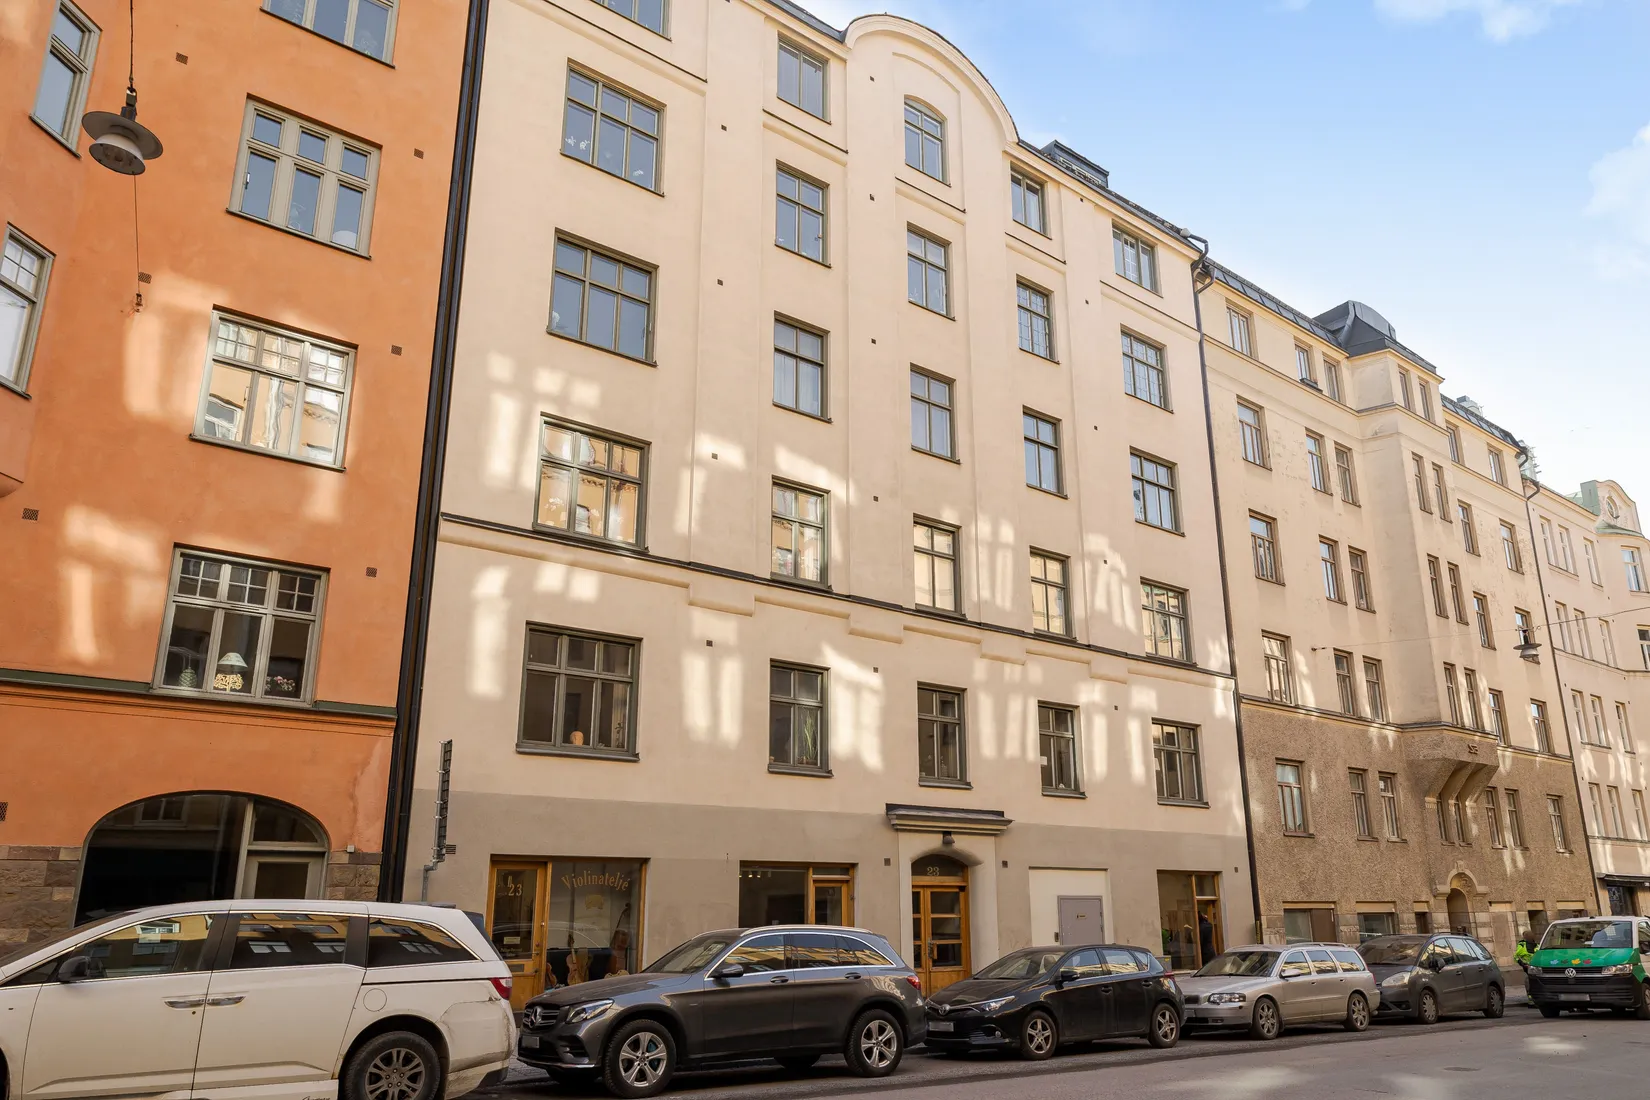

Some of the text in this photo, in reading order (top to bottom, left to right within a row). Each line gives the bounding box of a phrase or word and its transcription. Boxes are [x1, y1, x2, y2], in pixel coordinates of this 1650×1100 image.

[926, 866, 940, 877] 23
[561, 870, 630, 891] Violinateljé
[508, 883, 522, 896] 23
